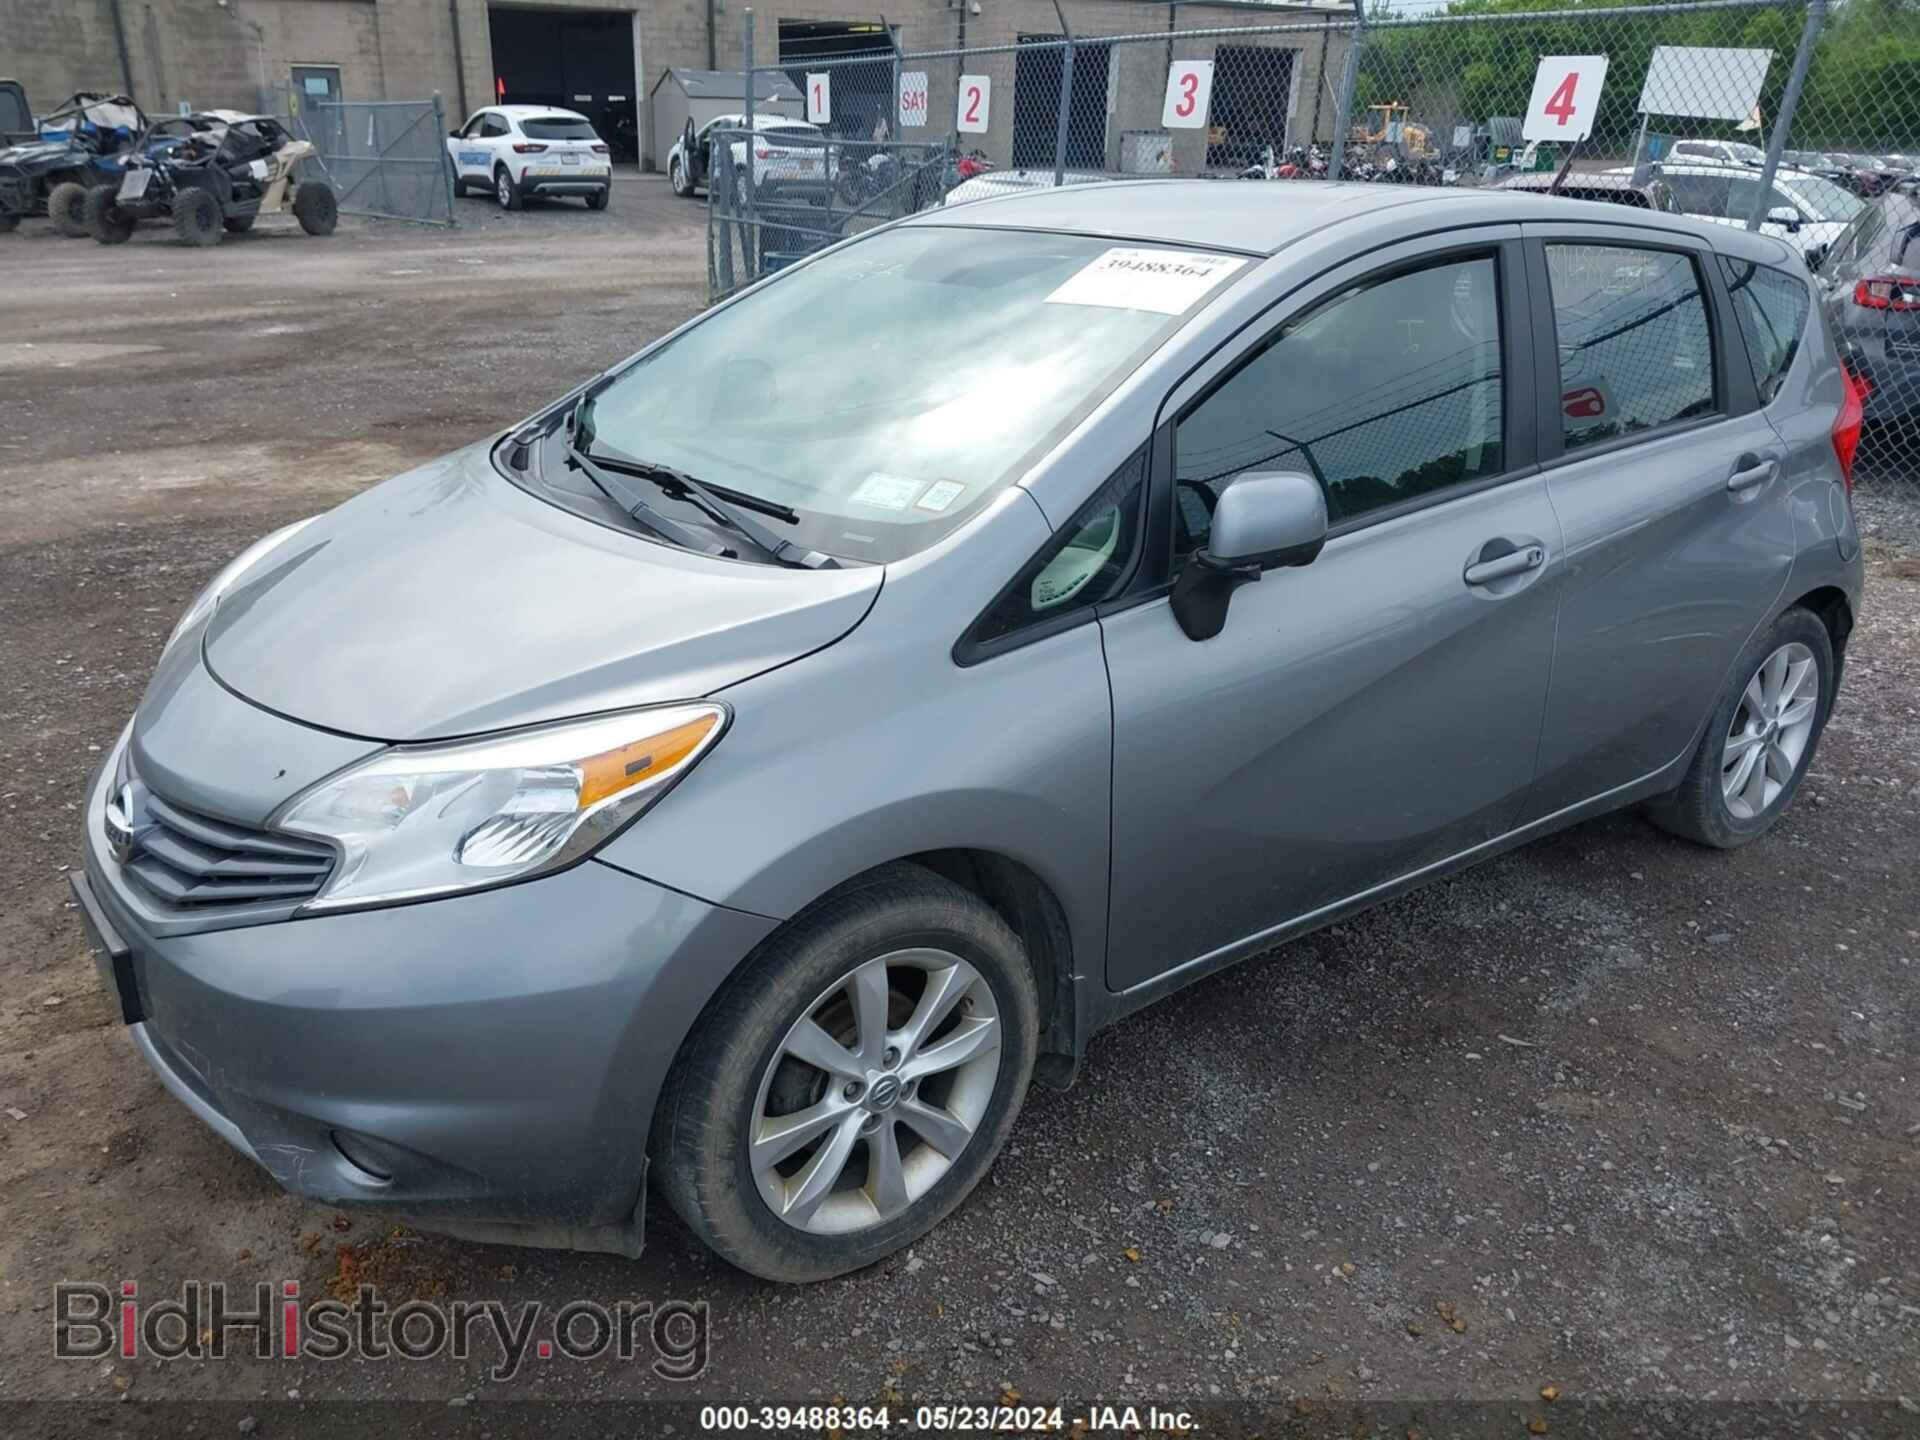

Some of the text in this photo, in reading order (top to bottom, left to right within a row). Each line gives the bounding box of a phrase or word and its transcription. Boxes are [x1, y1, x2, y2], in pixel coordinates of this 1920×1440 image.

[813, 83, 822, 114] 1
[902, 91, 927, 111] SA1
[965, 86, 981, 123] 2
[1175, 73, 1199, 117] 3
[1543, 72, 1580, 126] 4
[1107, 258, 1213, 278] 39488364
